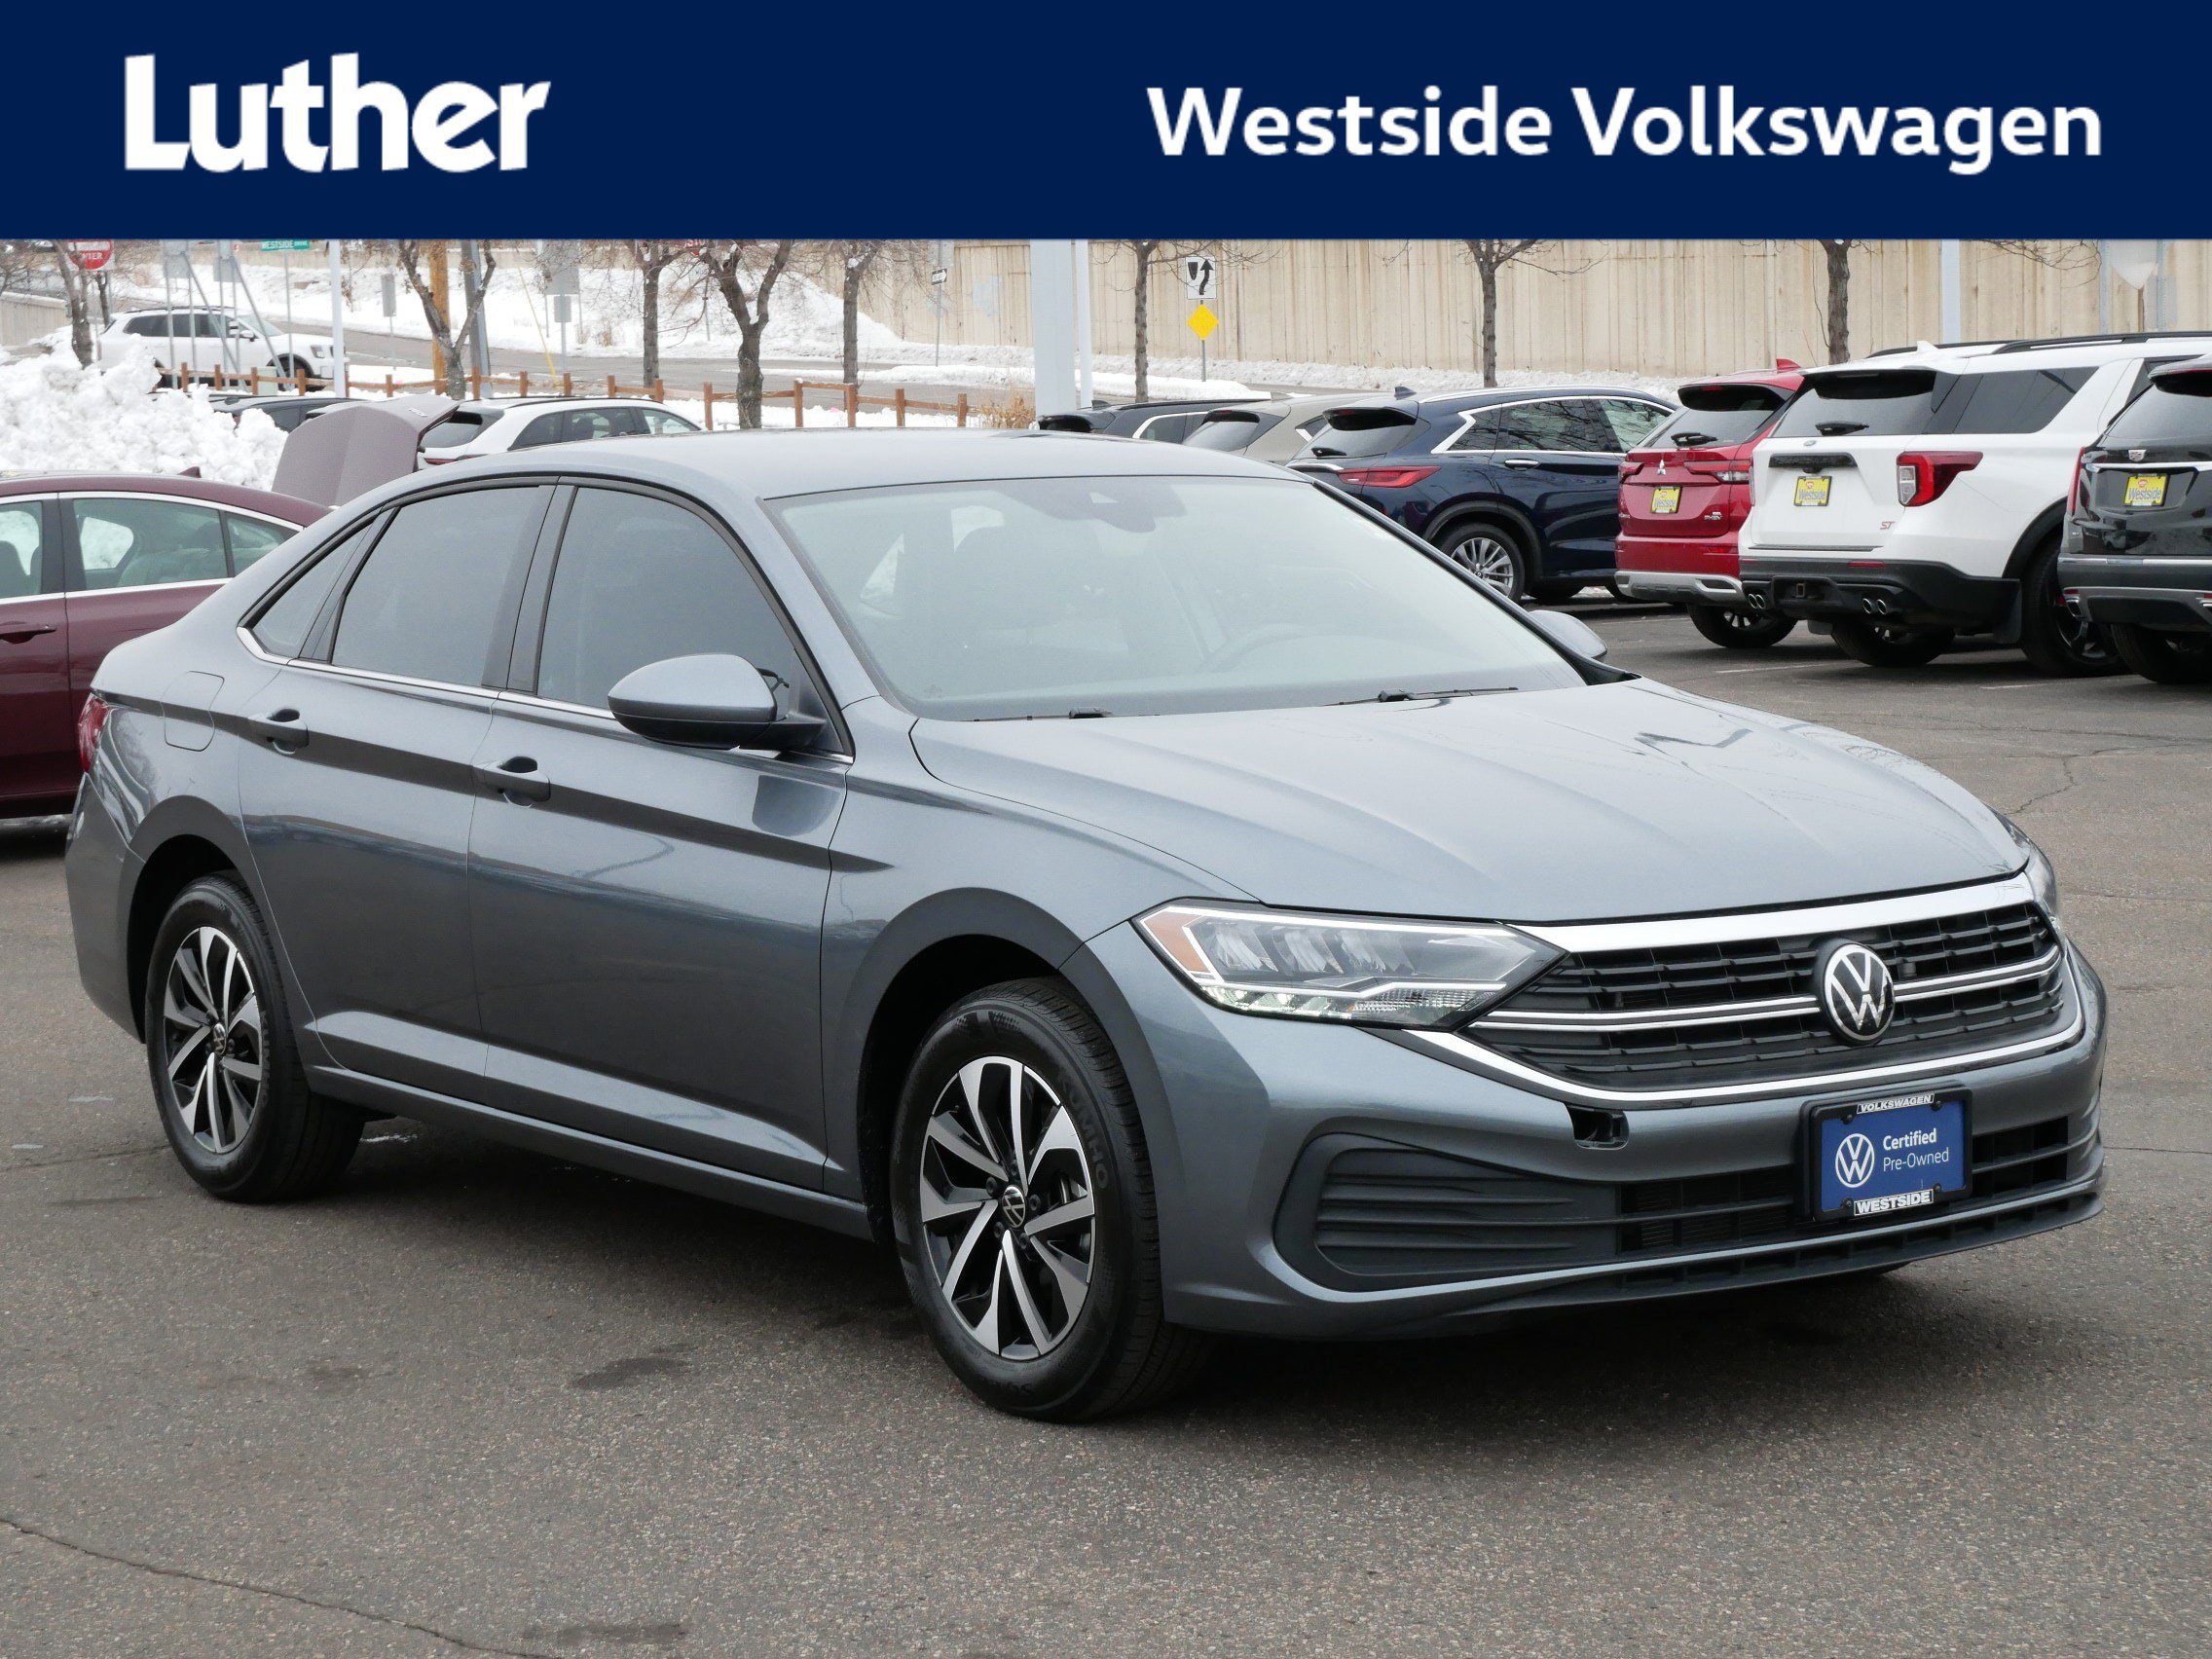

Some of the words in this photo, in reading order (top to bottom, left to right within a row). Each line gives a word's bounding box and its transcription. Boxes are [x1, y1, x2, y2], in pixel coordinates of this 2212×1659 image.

[2128, 488, 2161, 500] Westside
[1880, 521, 1896, 530] ST
[1860, 1094, 1933, 1113] VOLKSWAGEN
[1883, 1127, 1937, 1151] Certified
[1883, 1147, 1949, 1171] Pre-Owned
[1857, 1191, 1932, 1215] WESTSIDE
